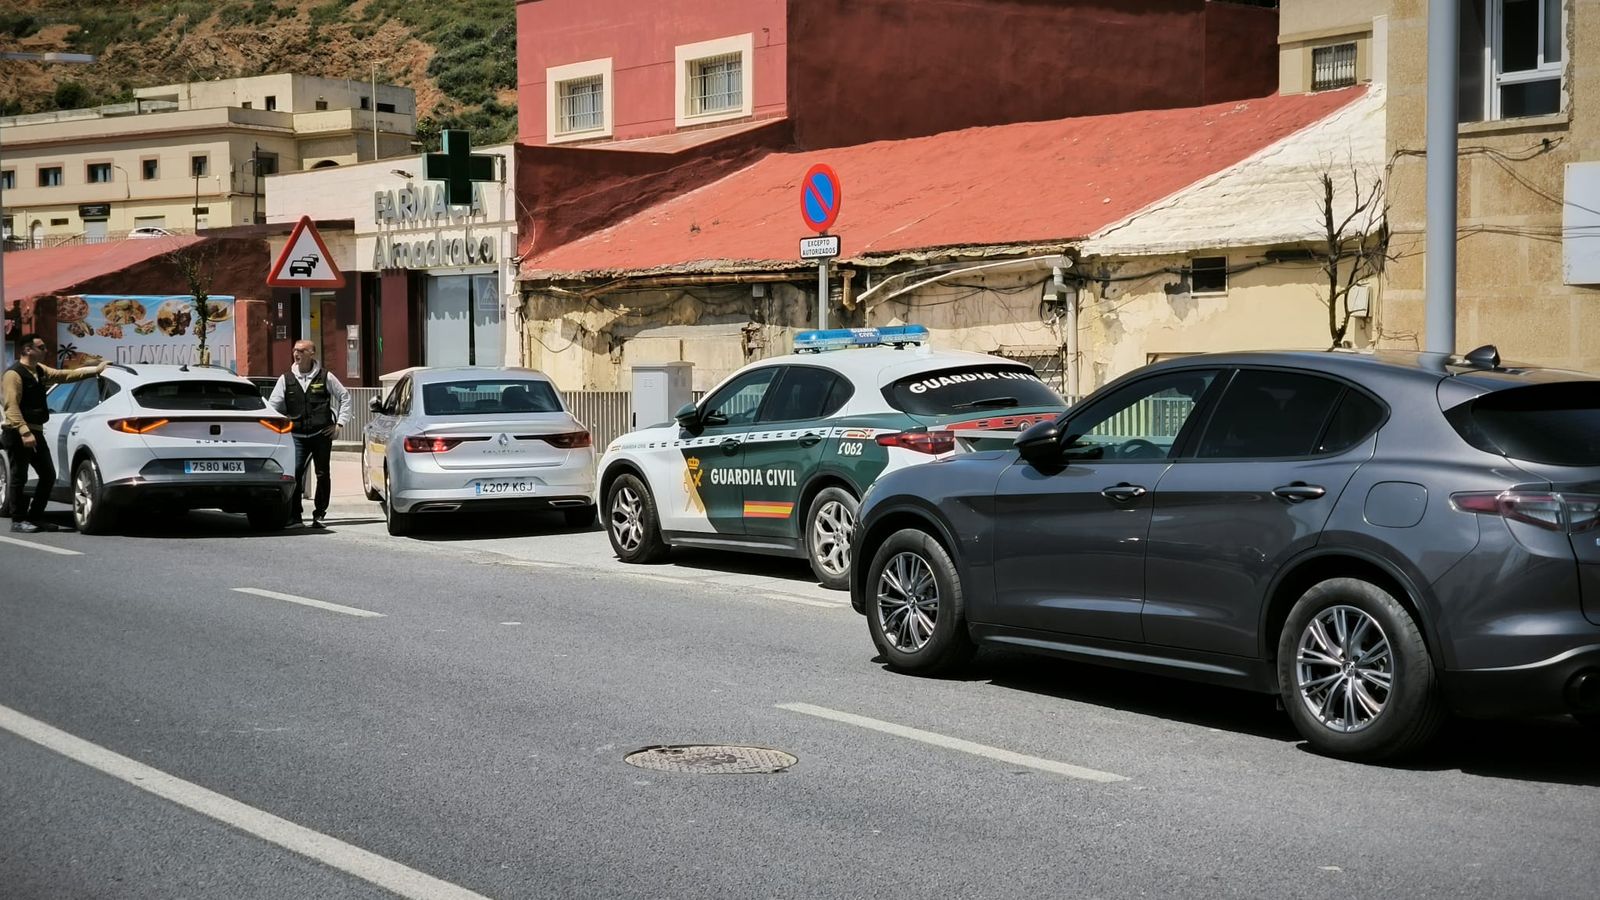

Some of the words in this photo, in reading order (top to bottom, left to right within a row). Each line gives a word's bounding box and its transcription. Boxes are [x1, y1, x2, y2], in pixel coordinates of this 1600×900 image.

[374, 182, 488, 226] FARMAA
[373, 227, 497, 270] Almadraba
[807, 239, 830, 247] EXCEPTO
[802, 247, 836, 256] AUTORIZADOS
[909, 371, 998, 394] GUARDIA
[844, 442, 863, 456] 062
[192, 462, 220, 472] 7580
[222, 462, 242, 472] MGX
[710, 467, 763, 486] GUARDIA
[766, 468, 797, 487] CIVIL
[483, 482, 509, 493] 4207
[512, 482, 533, 492] KGJ
